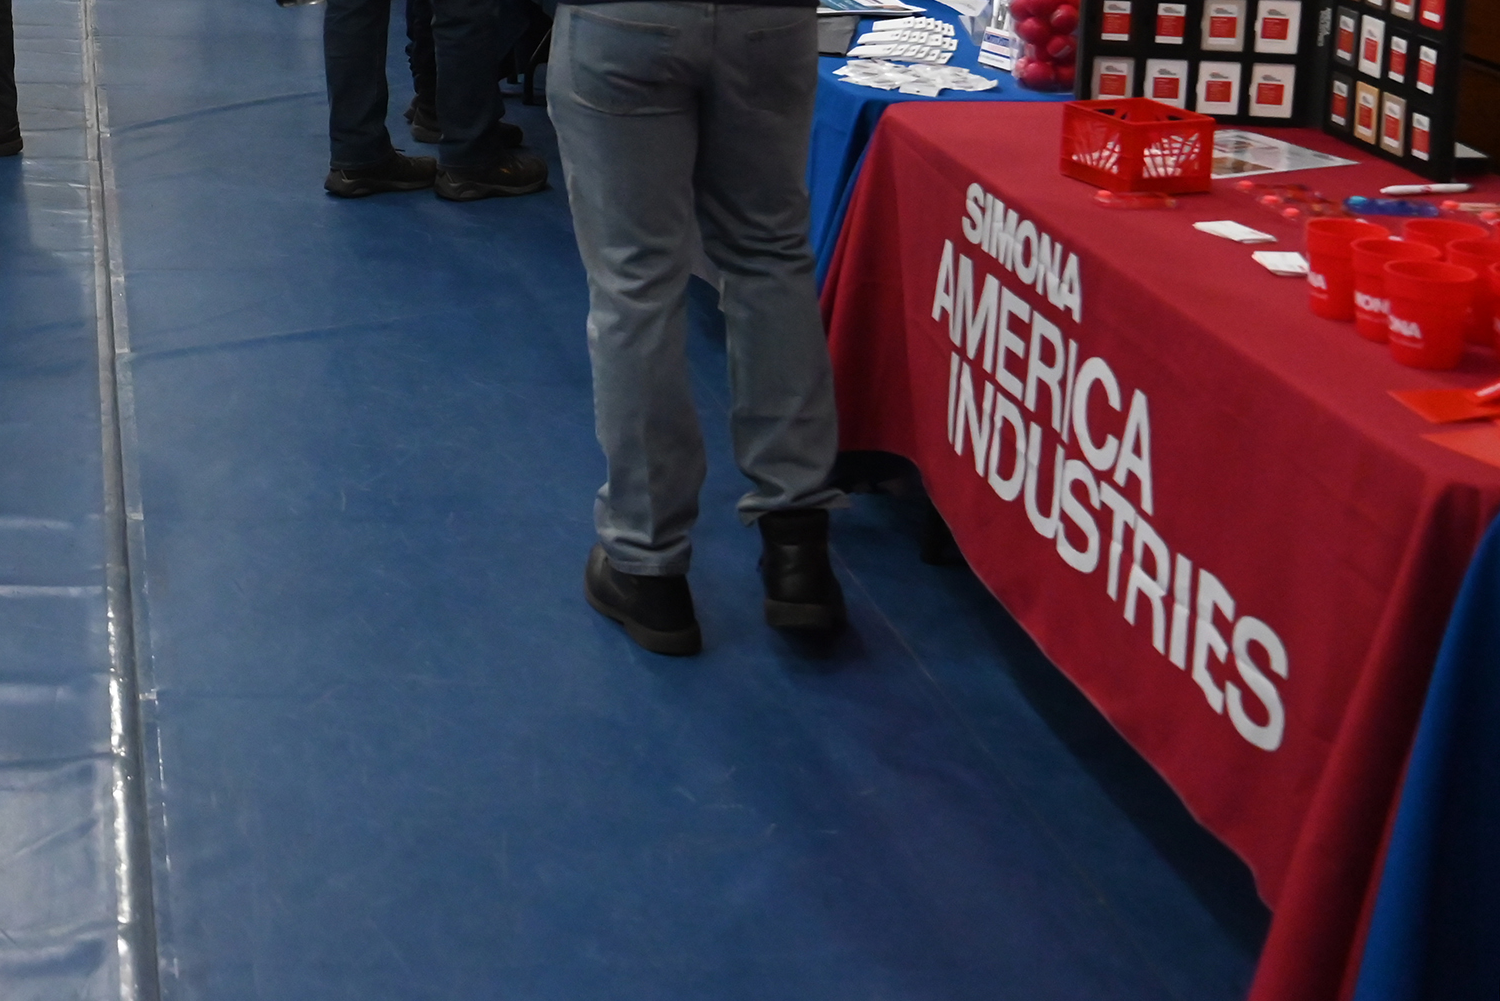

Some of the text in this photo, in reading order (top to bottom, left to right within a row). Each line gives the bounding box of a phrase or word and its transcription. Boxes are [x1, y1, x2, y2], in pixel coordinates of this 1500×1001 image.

[932, 239, 1154, 517] AMERICA
[961, 182, 1083, 323] SIMONA
[948, 351, 1290, 752] INDUSTRIES
